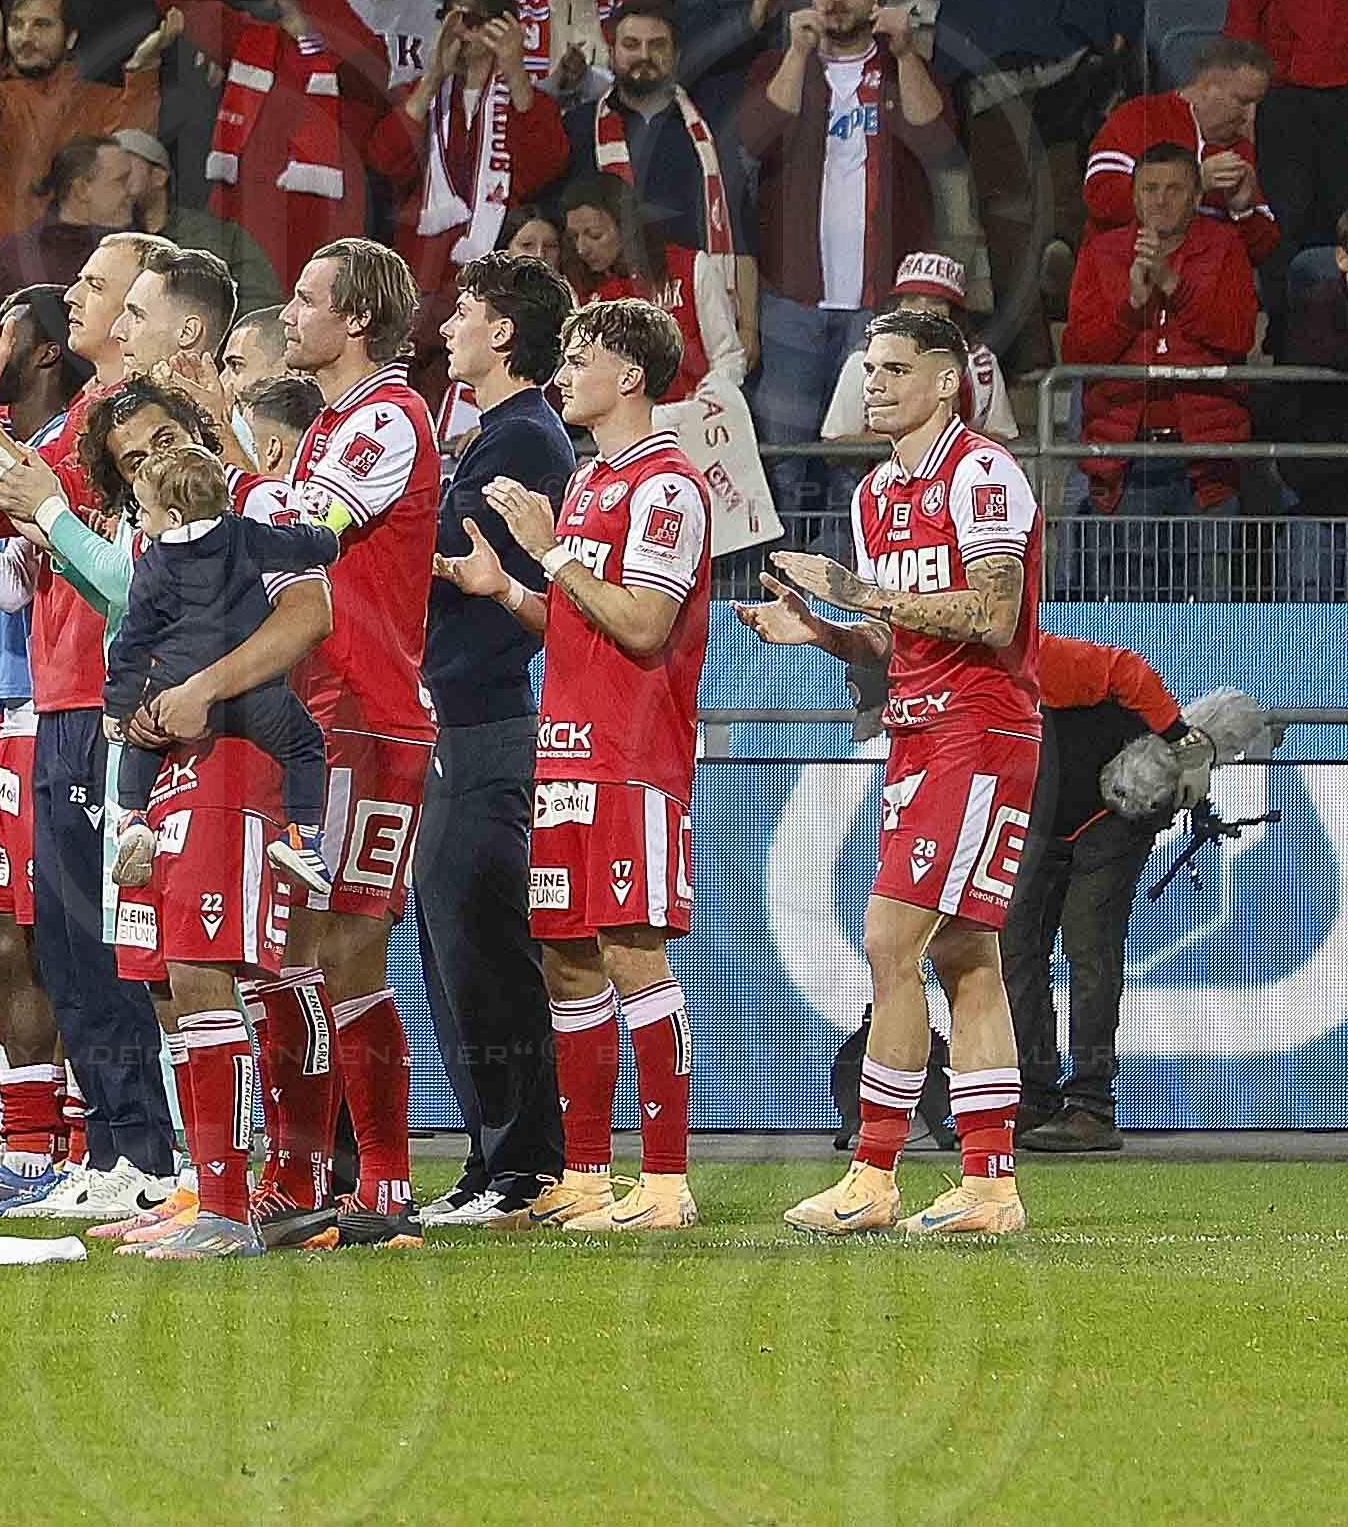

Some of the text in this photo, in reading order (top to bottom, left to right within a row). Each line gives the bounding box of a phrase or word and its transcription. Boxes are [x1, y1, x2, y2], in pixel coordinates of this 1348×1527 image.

[69, 785, 87, 803] 25
[356, 812, 404, 877] E
[912, 837, 937, 858] 28
[612, 861, 632, 878] 17
[530, 872, 565, 887] EINE
[200, 893, 224, 912] 22
[531, 887, 565, 905] TUNG
[316, 1044, 328, 1073] GRAZ
